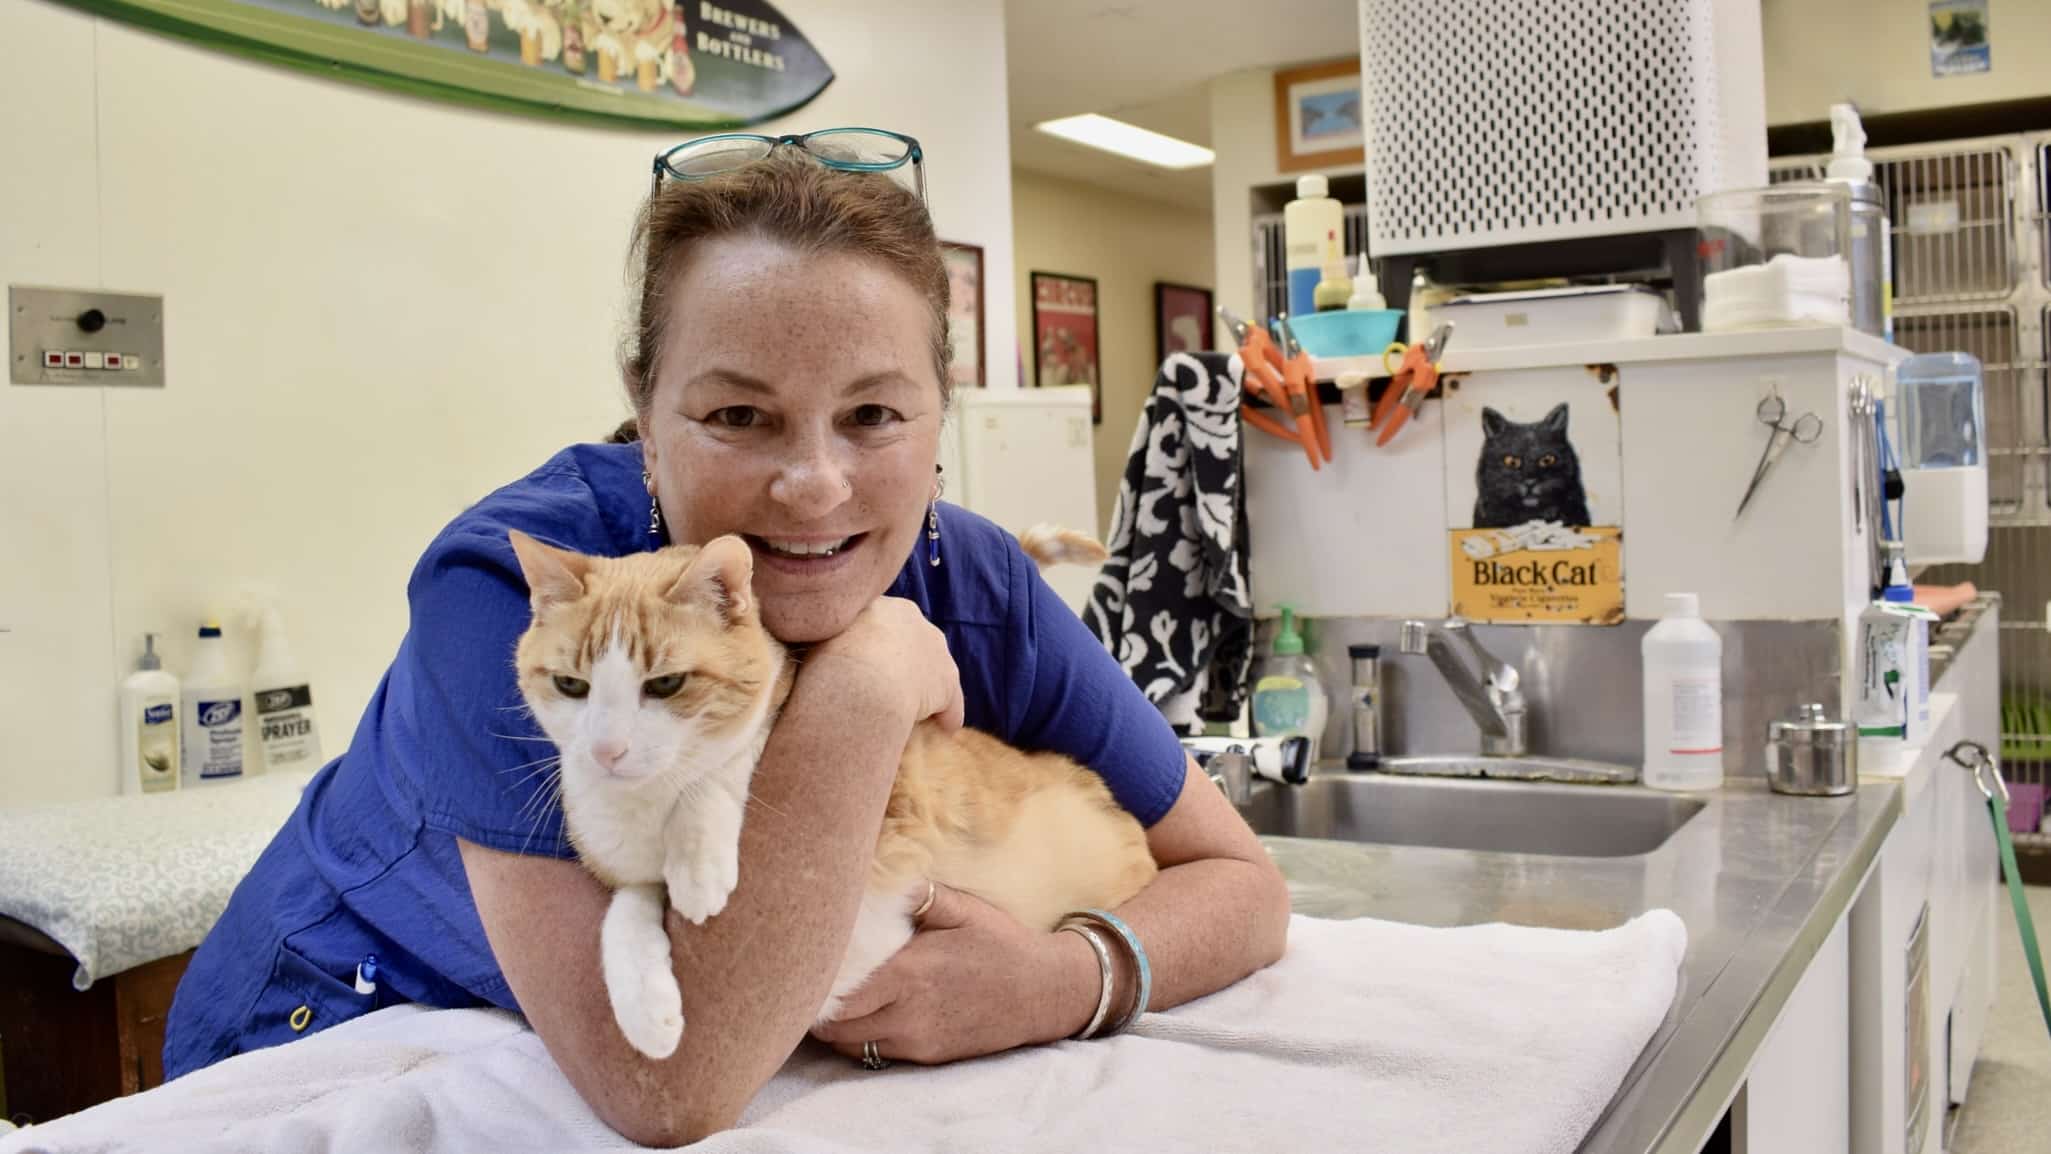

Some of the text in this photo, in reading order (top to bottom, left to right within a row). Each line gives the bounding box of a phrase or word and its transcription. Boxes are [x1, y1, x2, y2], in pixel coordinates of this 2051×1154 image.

[701, 1, 781, 40] BREWERS
[696, 31, 785, 71] BOTTLERS
[1473, 560, 1598, 586] Black Cat
